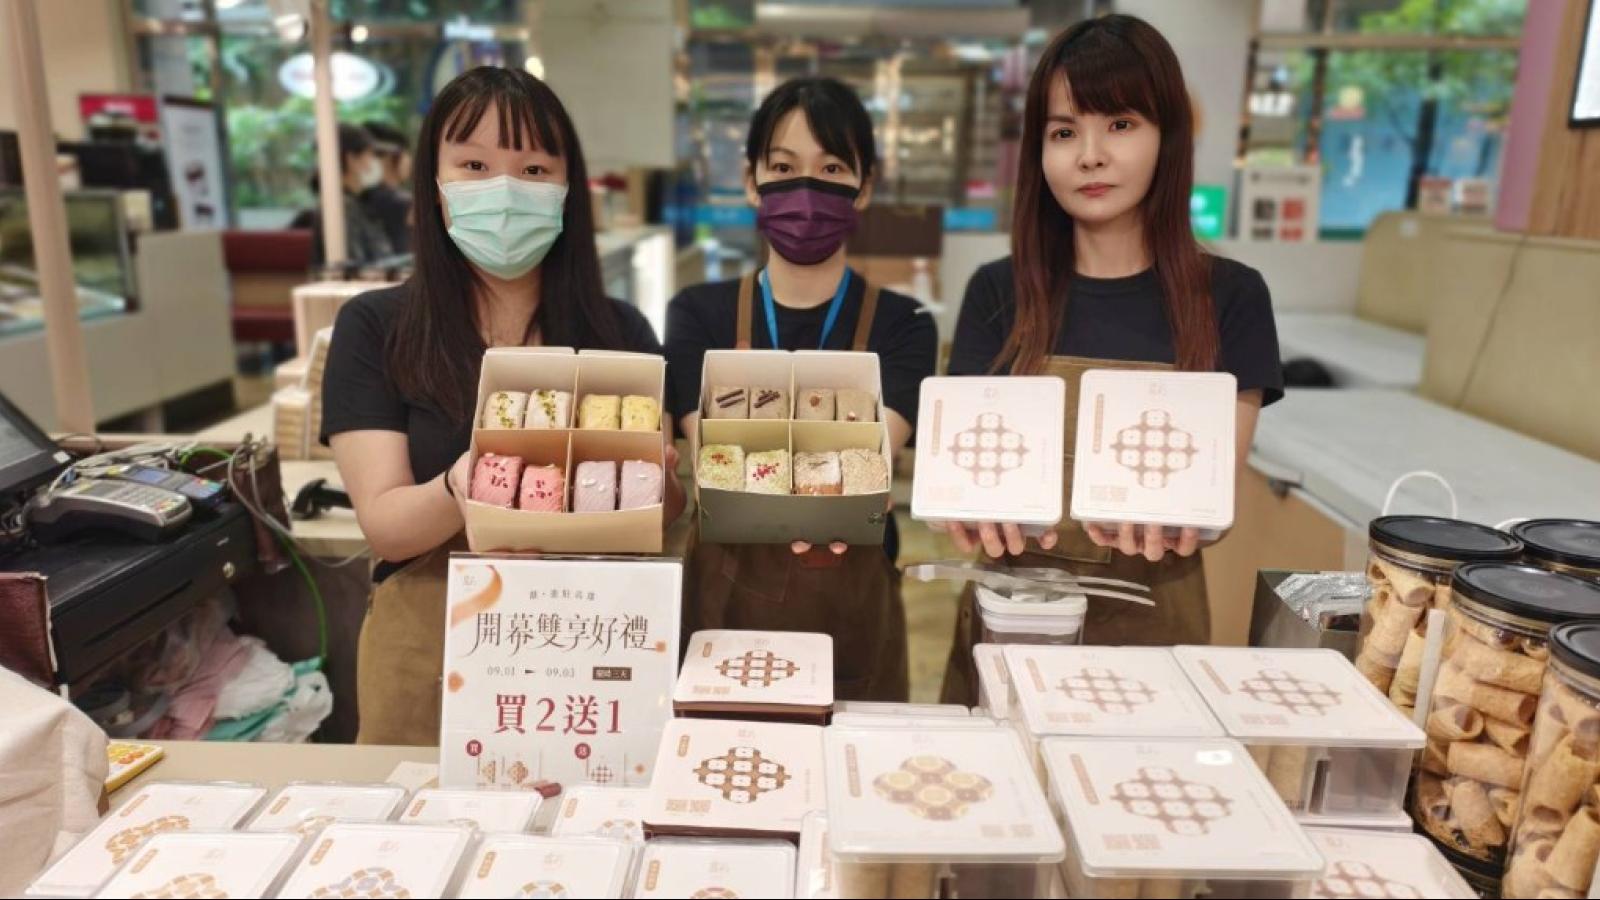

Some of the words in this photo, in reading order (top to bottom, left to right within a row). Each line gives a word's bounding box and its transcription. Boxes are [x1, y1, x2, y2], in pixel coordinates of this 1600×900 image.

[463, 612, 655, 656] 開幕雙享好禮
[494, 693, 623, 735] 買2送1
